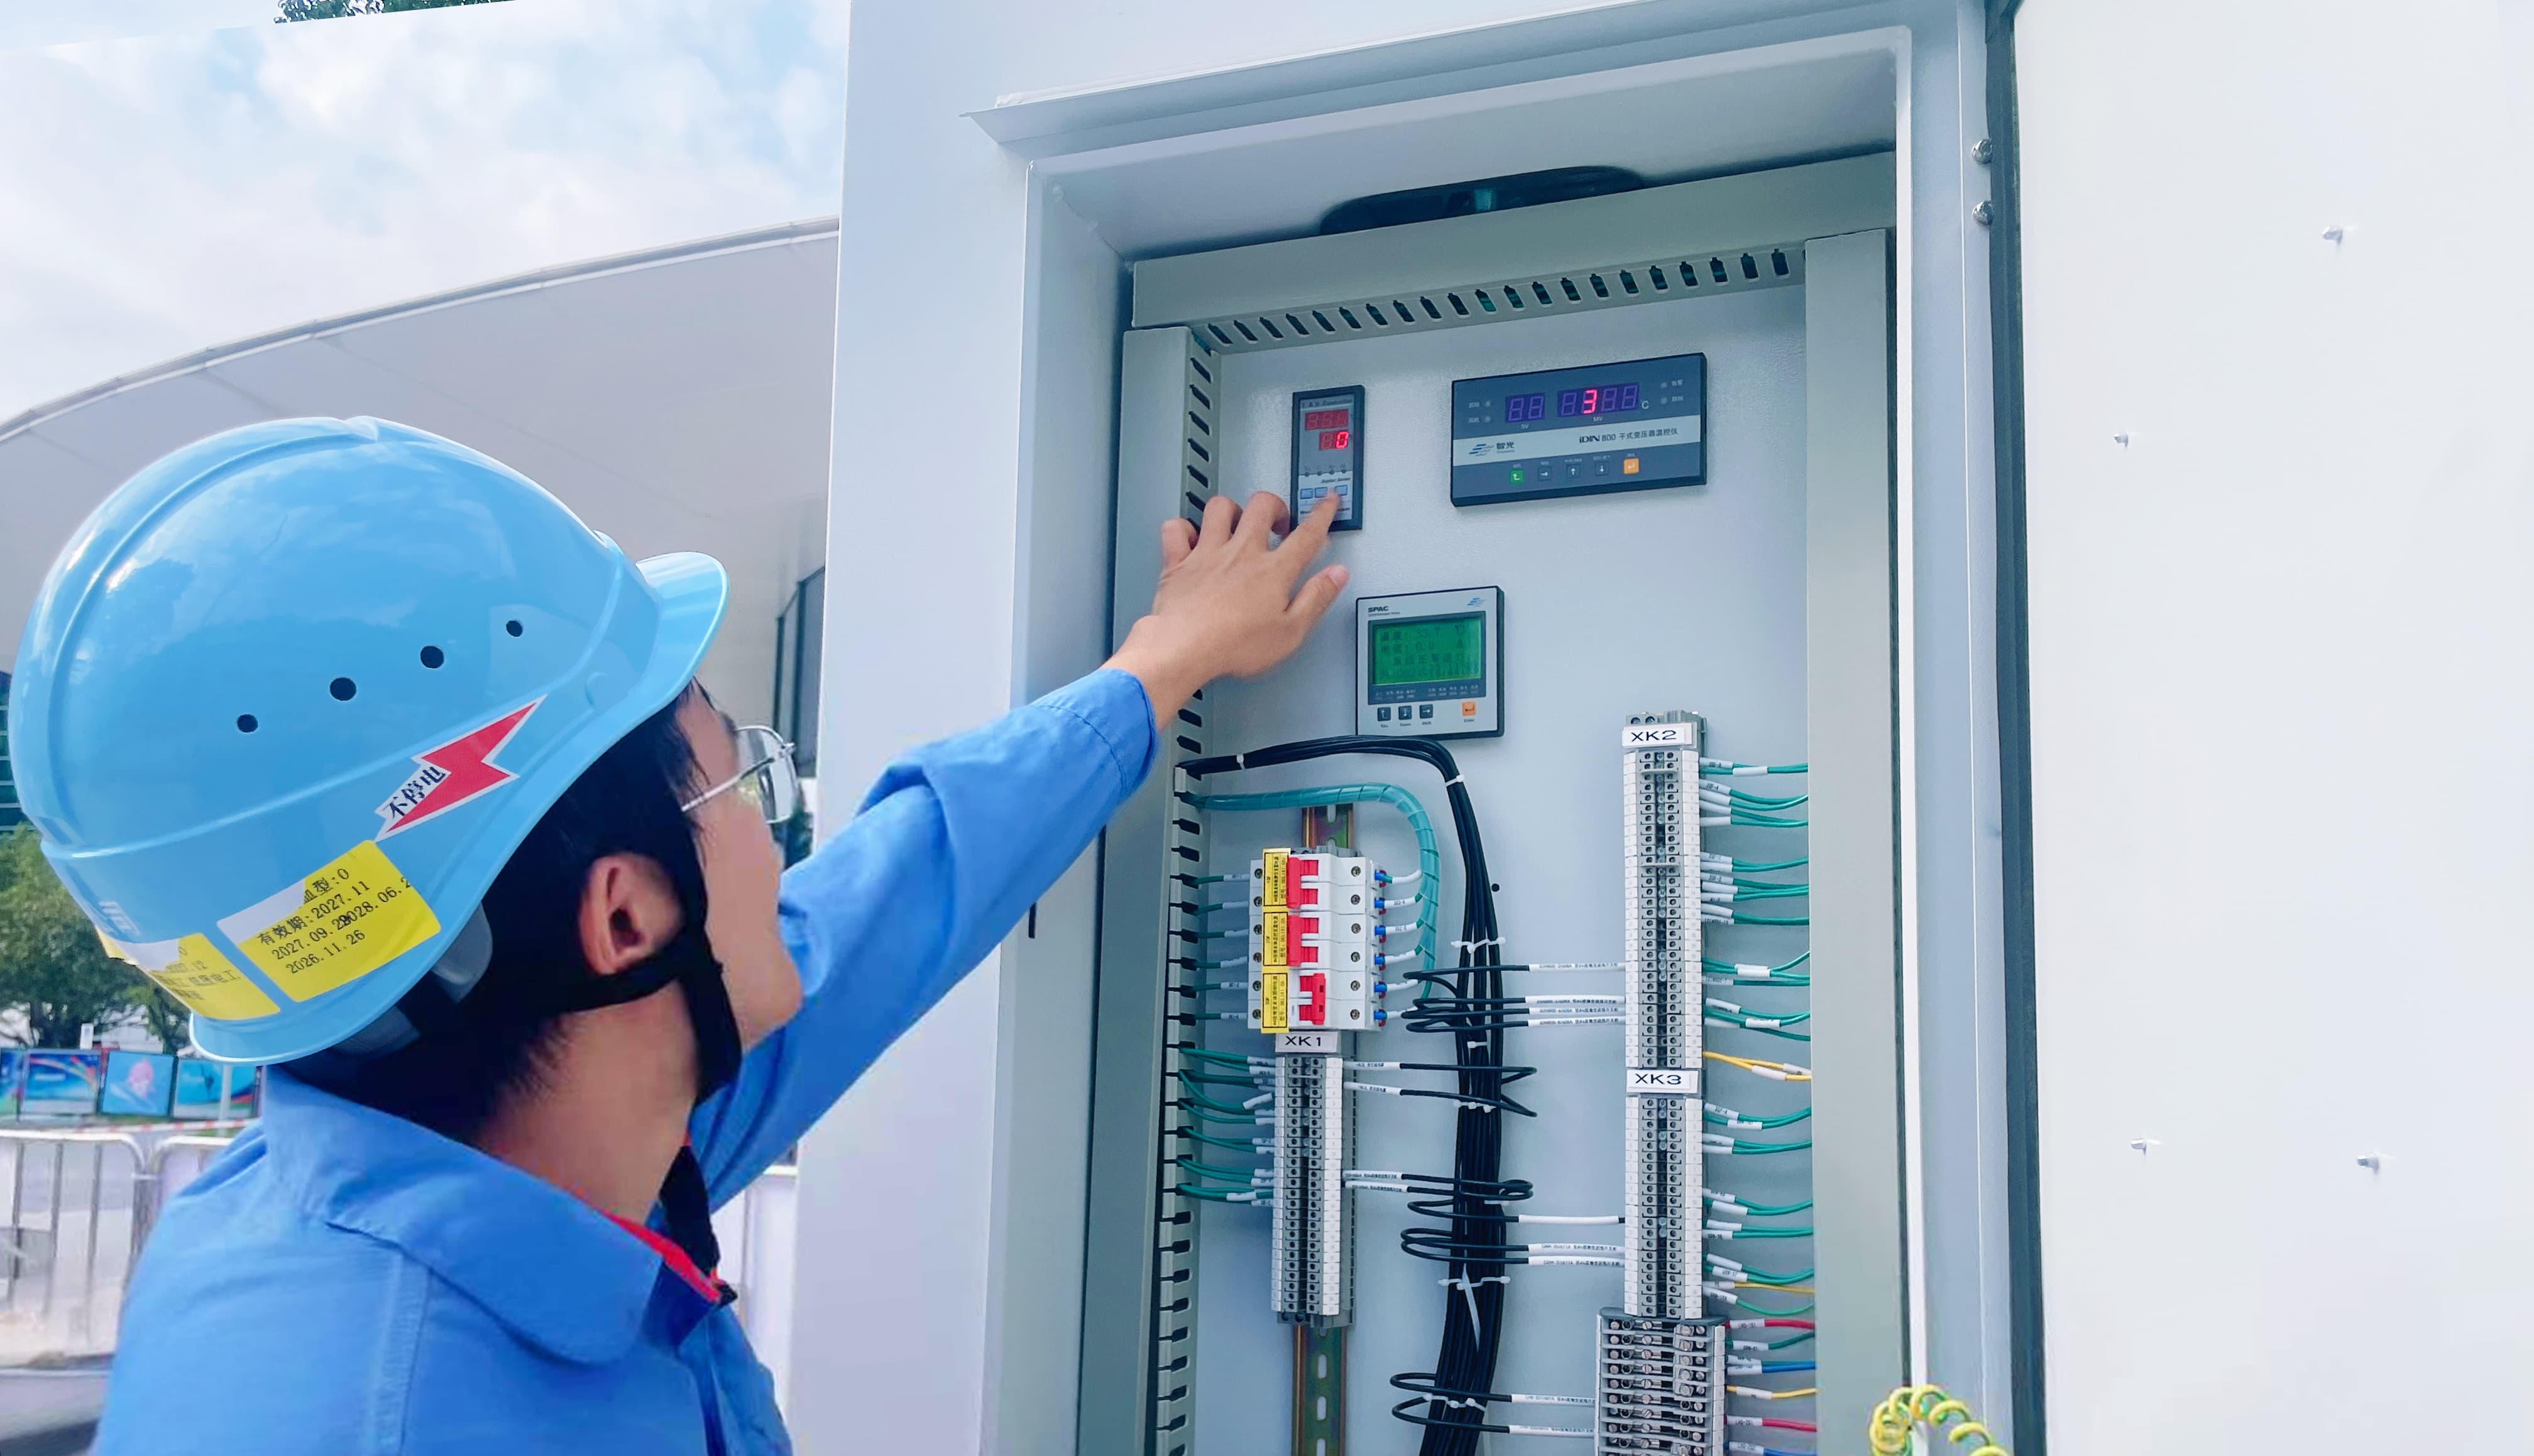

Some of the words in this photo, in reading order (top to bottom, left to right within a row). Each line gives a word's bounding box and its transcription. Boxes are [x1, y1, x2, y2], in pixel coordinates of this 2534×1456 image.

[1601, 433, 1616, 441] 800
[1630, 730, 1677, 742] XK2
[383, 767, 446, 819] 不停电
[1285, 1036, 1322, 1047] XK1
[1635, 1073, 1682, 1085] XK3
